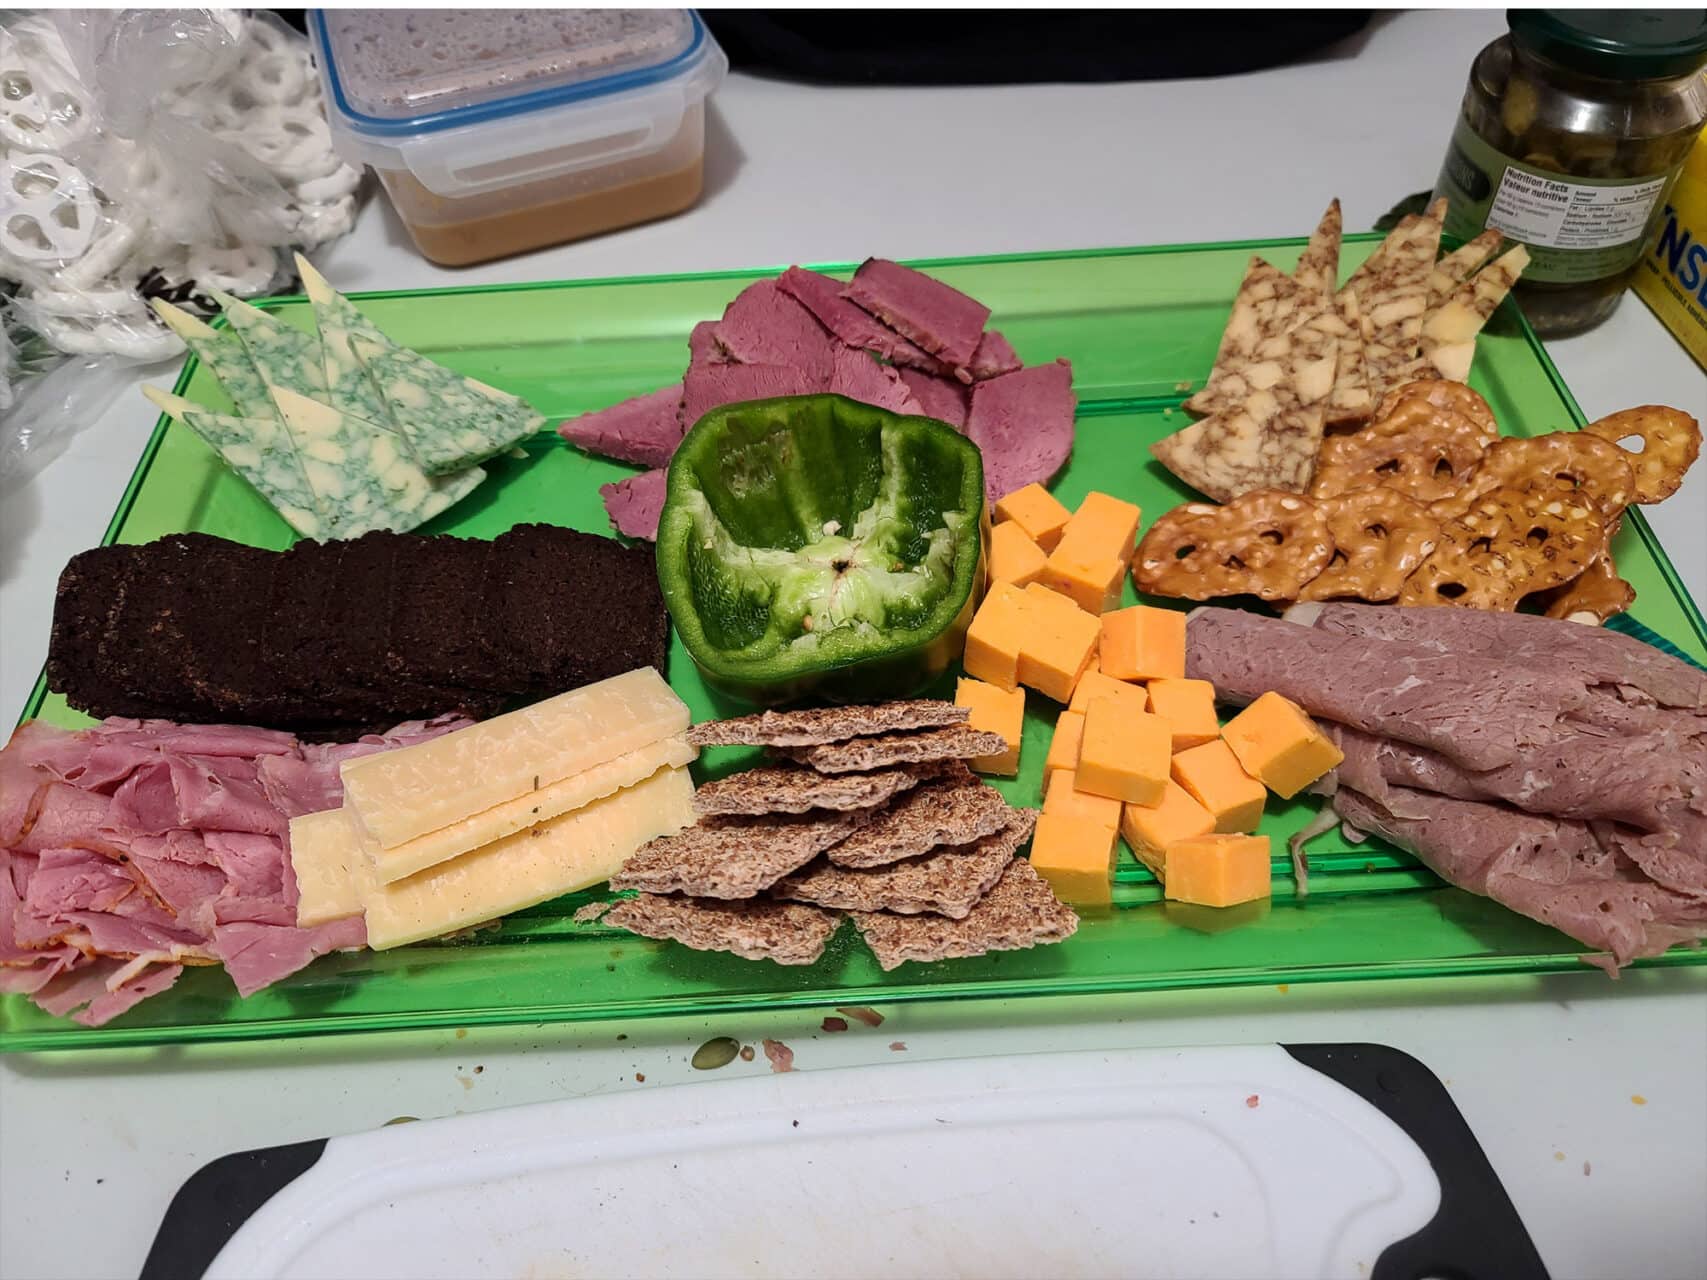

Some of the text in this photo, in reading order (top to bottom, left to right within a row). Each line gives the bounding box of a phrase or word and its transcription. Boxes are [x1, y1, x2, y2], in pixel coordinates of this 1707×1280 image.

[1503, 177, 1569, 203] Valeur nutritive
[1506, 168, 1569, 193] Nutrition Facts
